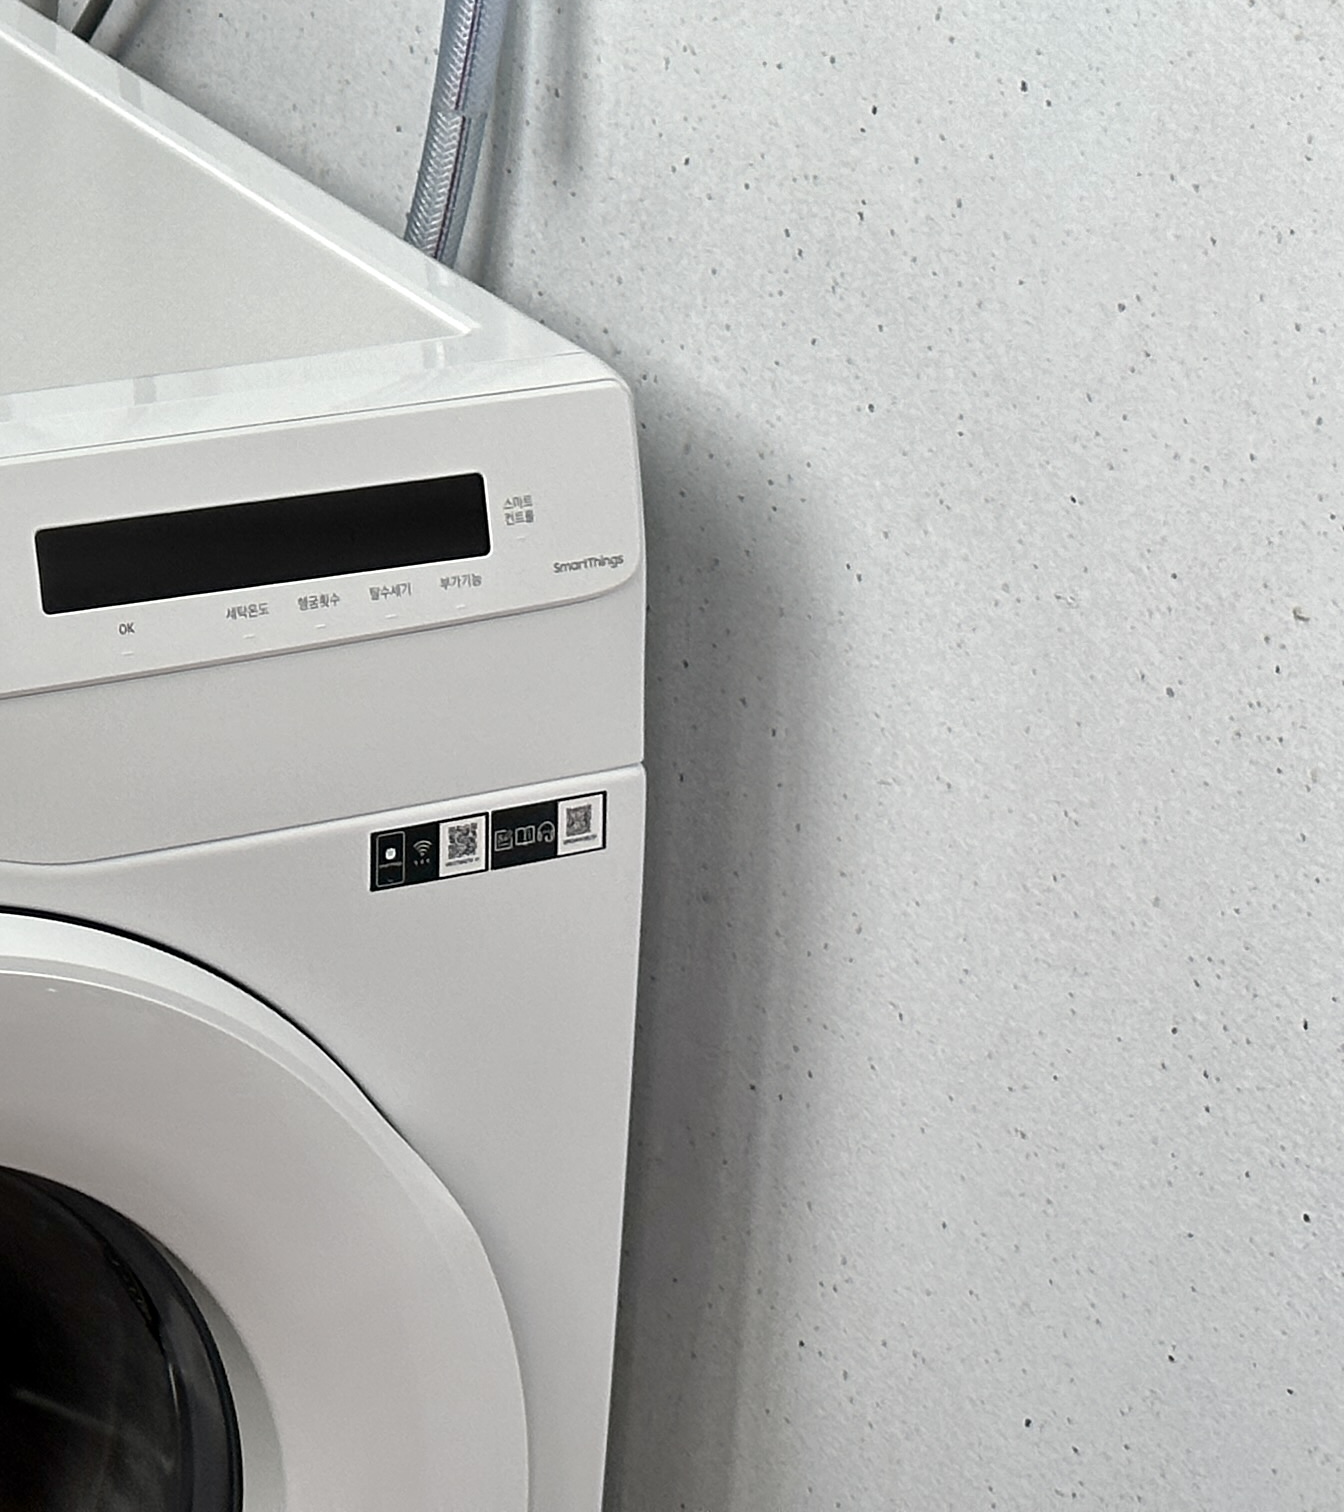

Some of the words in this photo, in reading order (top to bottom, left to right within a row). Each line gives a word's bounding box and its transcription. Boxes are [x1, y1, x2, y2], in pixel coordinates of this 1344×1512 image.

[503, 494, 533, 509] 스마트
[504, 509, 534, 526] 컨트롤
[553, 554, 624, 574] SmartThings
[440, 573, 482, 590] 부가기능
[369, 582, 412, 601] 탈수세기
[297, 593, 341, 611] 헹굼횟수
[226, 602, 270, 620] 세탁온도
[118, 622, 135, 635] OK
